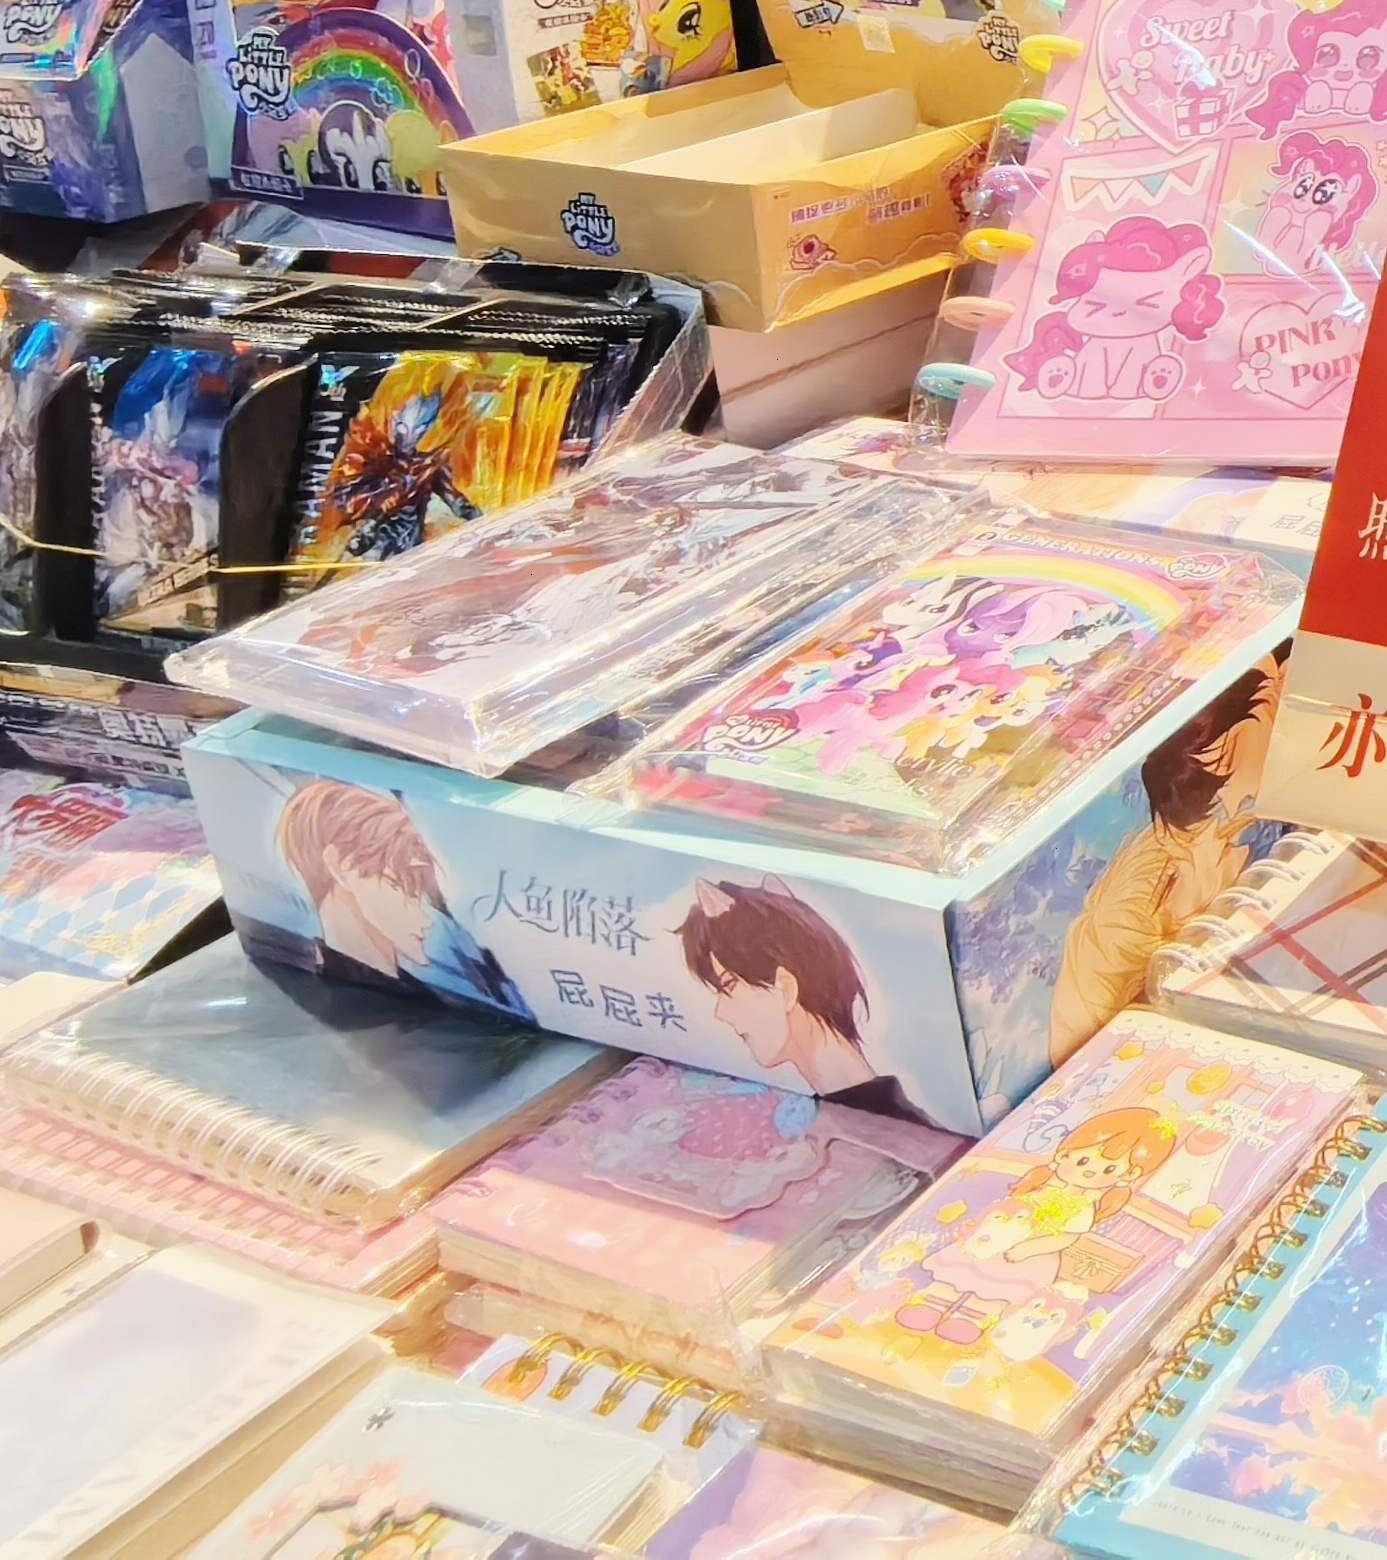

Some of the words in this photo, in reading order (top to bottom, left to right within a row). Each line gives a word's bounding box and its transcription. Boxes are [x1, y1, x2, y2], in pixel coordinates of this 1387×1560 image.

[1139, 9, 1236, 48] Sweet
[238, 44, 288, 65] LITTLE
[227, 59, 292, 95] PONY
[1002, 530, 1164, 568] GENERATIONS
[474, 867, 654, 957] 人鱼陷落
[550, 970, 689, 1036] 屁屁夹
